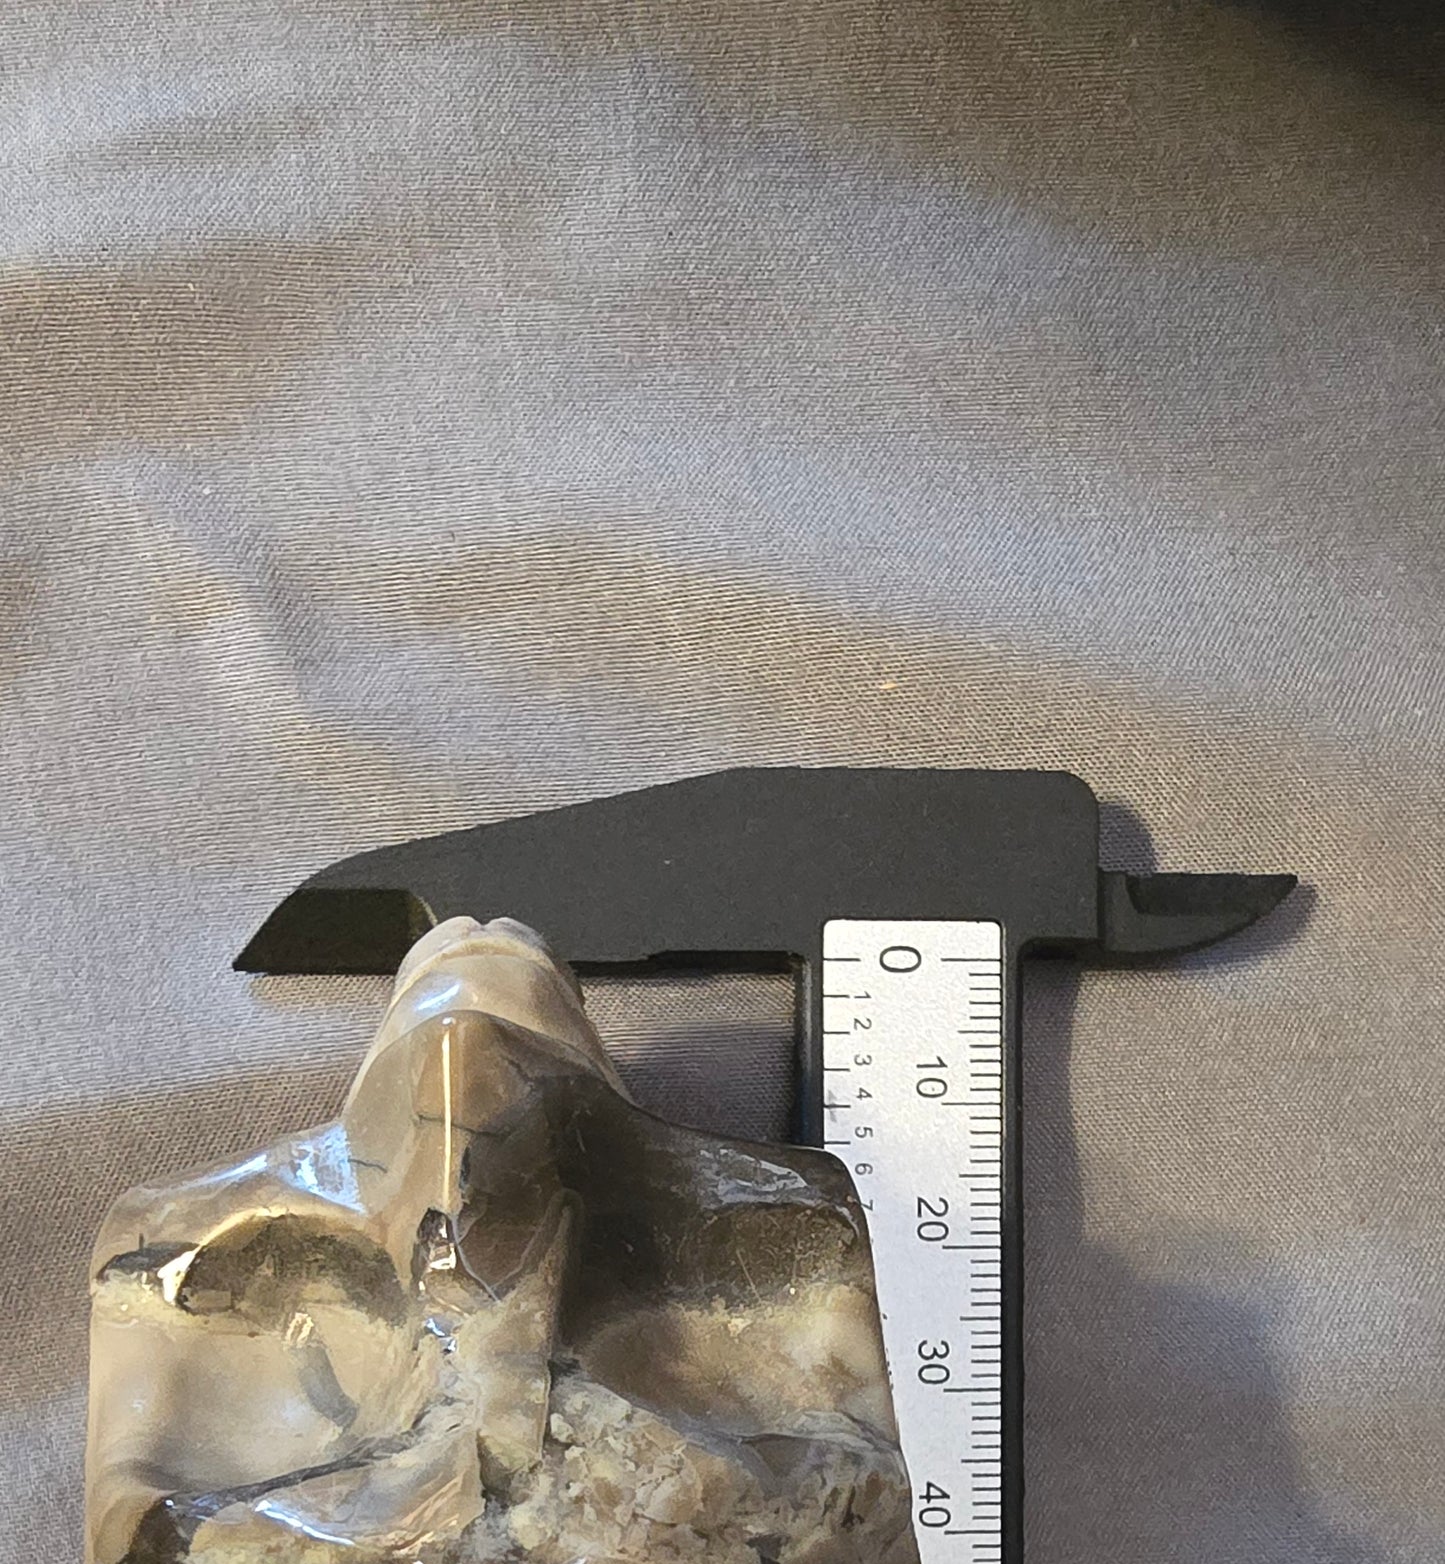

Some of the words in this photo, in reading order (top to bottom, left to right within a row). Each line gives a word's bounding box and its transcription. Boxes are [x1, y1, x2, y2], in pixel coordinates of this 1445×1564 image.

[879, 945, 922, 974] 0
[853, 991, 872, 999] 1
[853, 1018, 872, 1030] 2
[853, 1054, 873, 1066] 3
[915, 1055, 948, 1099] 10
[856, 1087, 873, 1100] 4
[854, 1126, 874, 1139] 5
[854, 1162, 874, 1176] 6
[916, 1196, 950, 1242] 20
[917, 1339, 951, 1385] 30
[918, 1481, 952, 1528] 40
